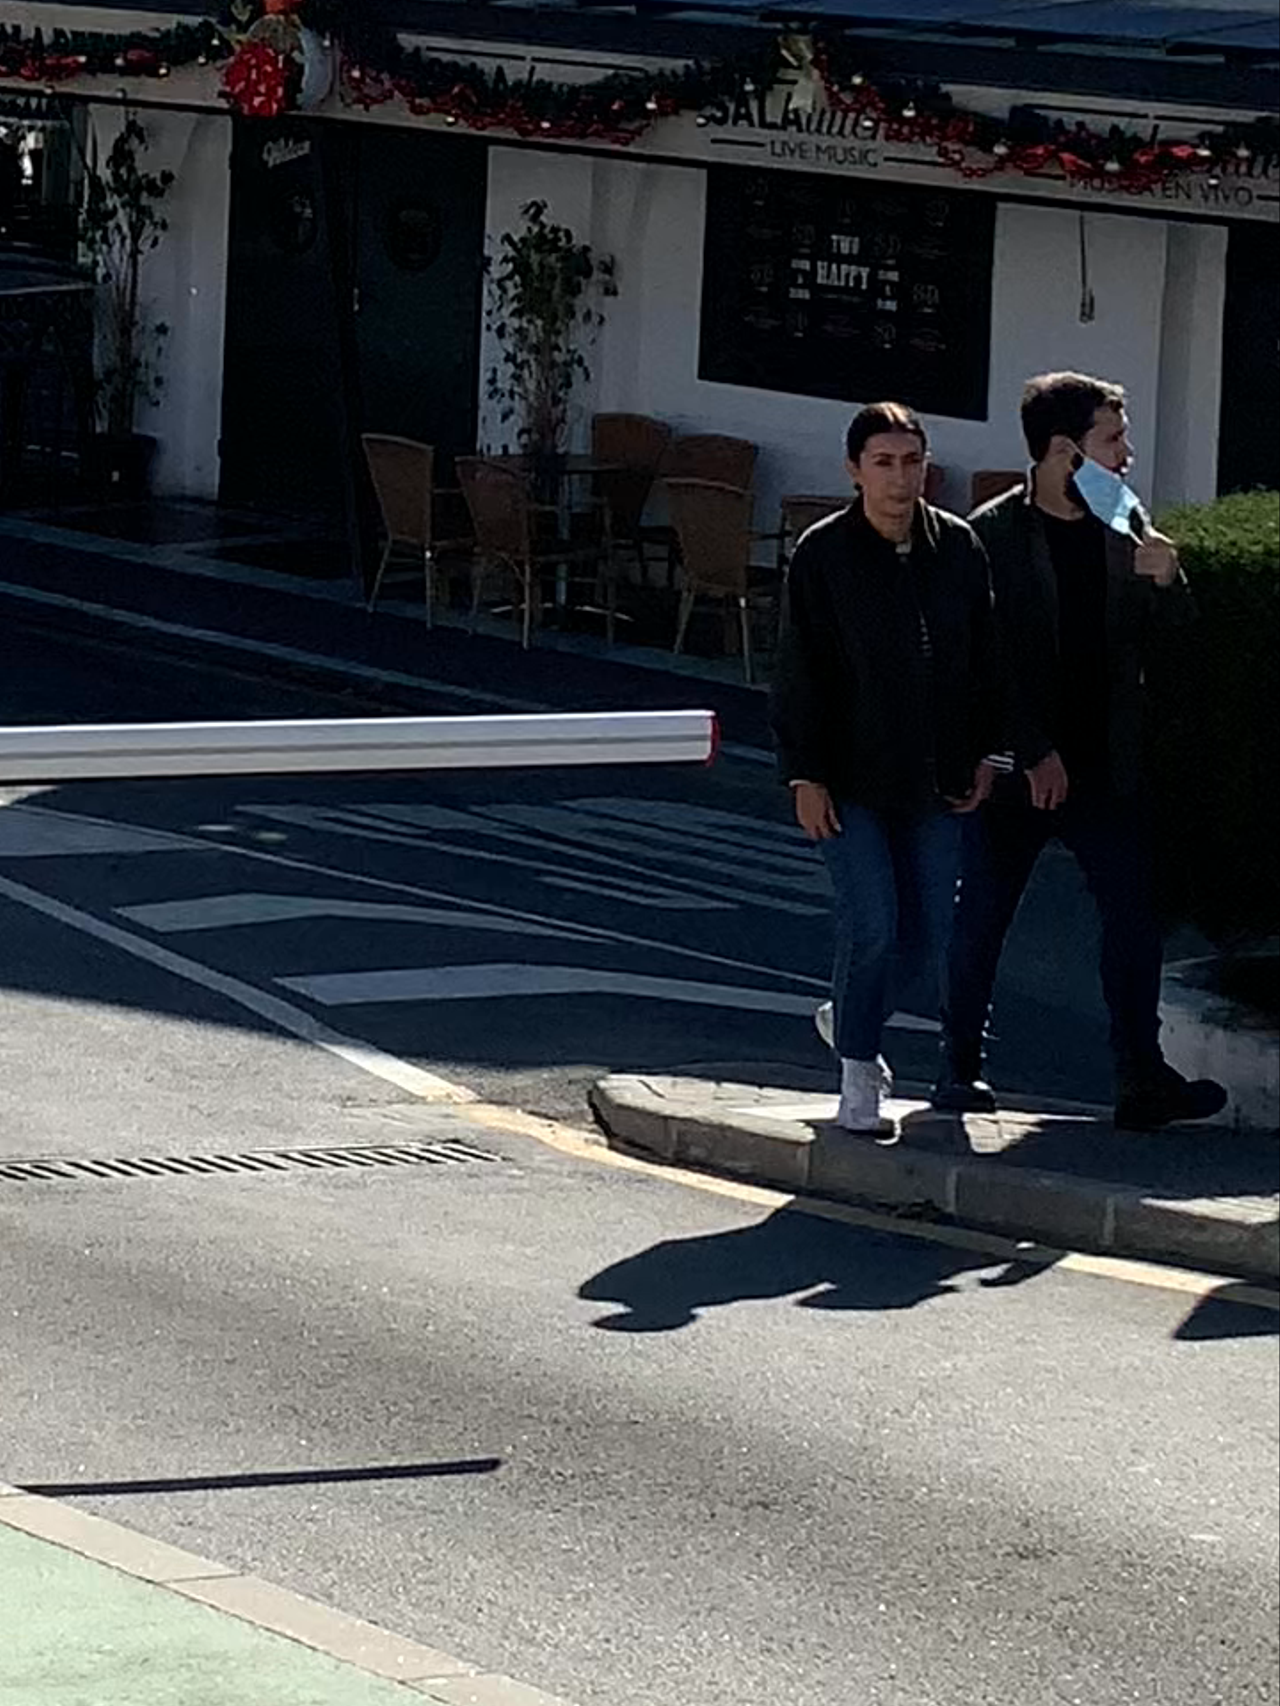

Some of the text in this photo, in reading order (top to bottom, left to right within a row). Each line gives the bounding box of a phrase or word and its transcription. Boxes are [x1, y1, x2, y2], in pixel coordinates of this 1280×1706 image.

[770, 140, 879, 168] LIVE MUSIC
[816, 260, 871, 291] HAPPY
